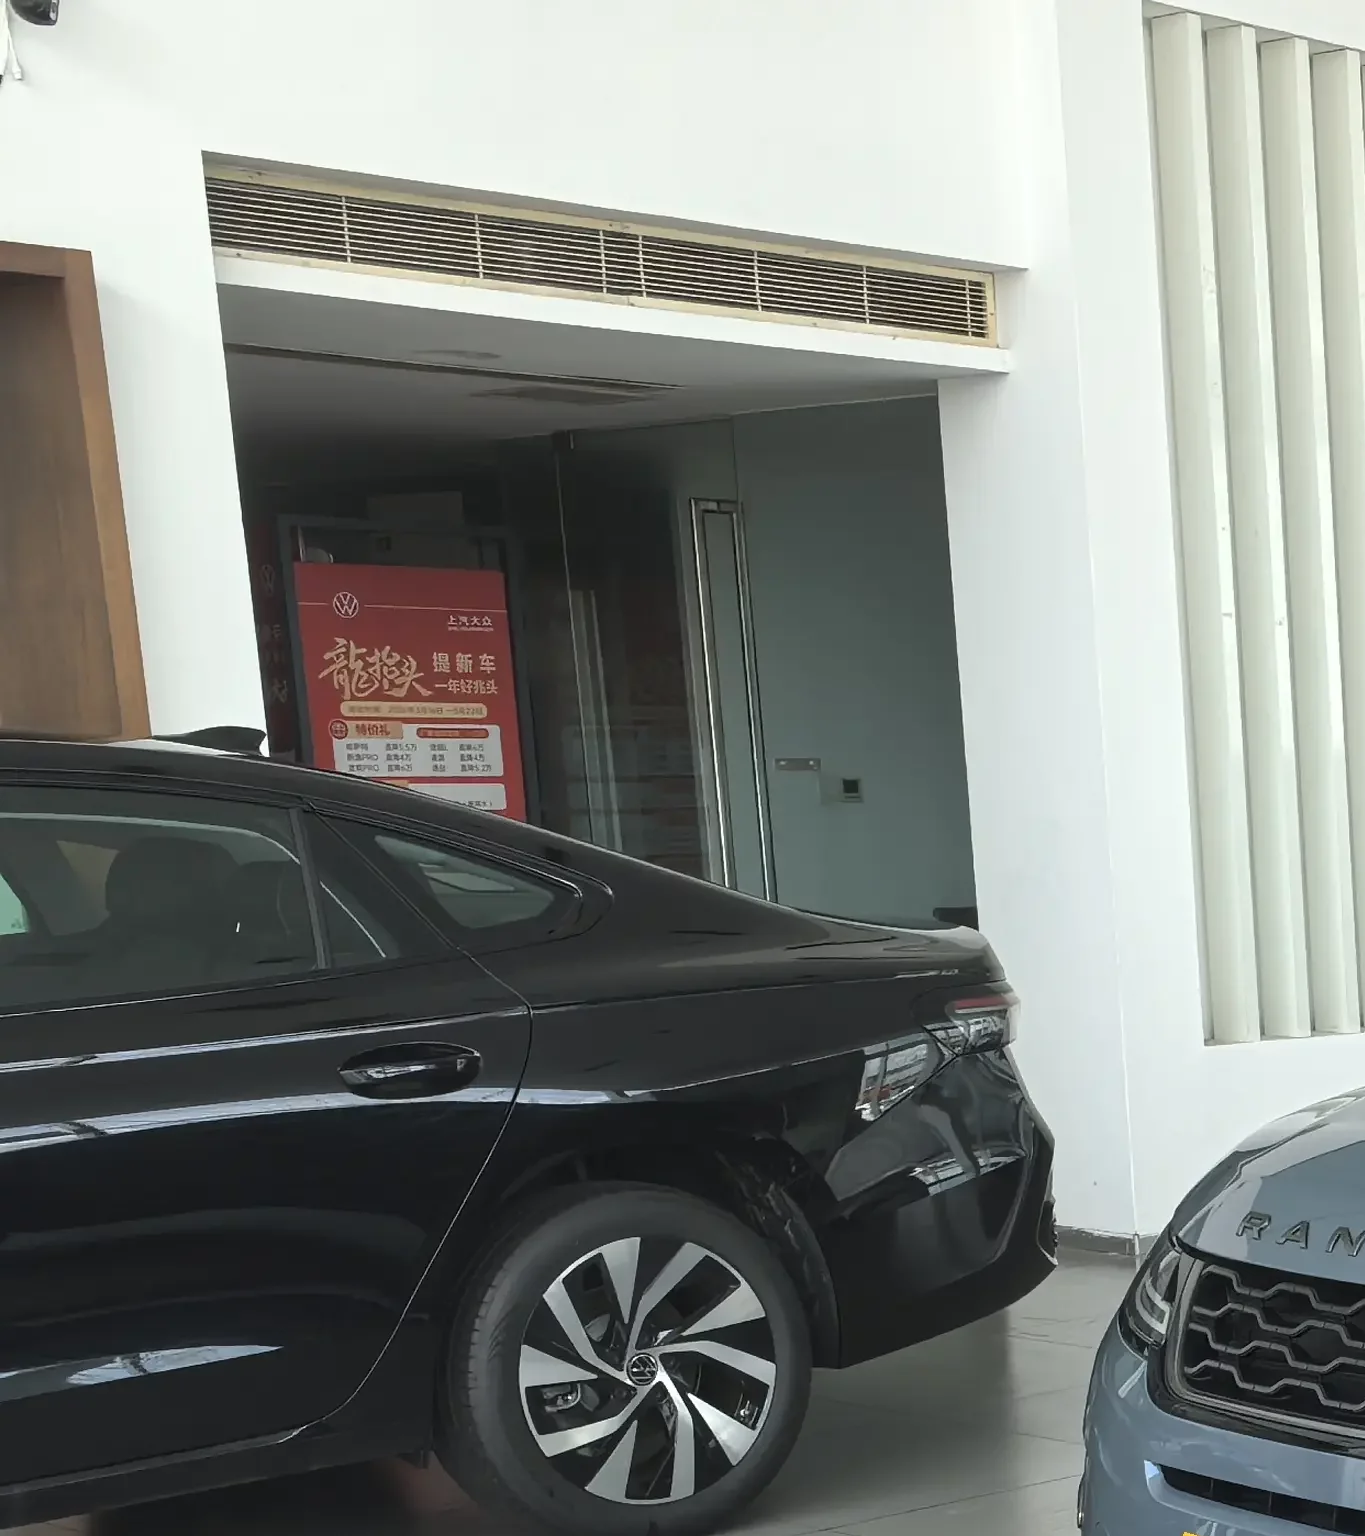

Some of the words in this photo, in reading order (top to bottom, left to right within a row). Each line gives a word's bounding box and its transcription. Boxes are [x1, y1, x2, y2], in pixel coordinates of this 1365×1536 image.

[448, 614, 493, 626] 上汽大众
[434, 678, 499, 695] 一年好兆头
[355, 722, 391, 737] 特价礼
